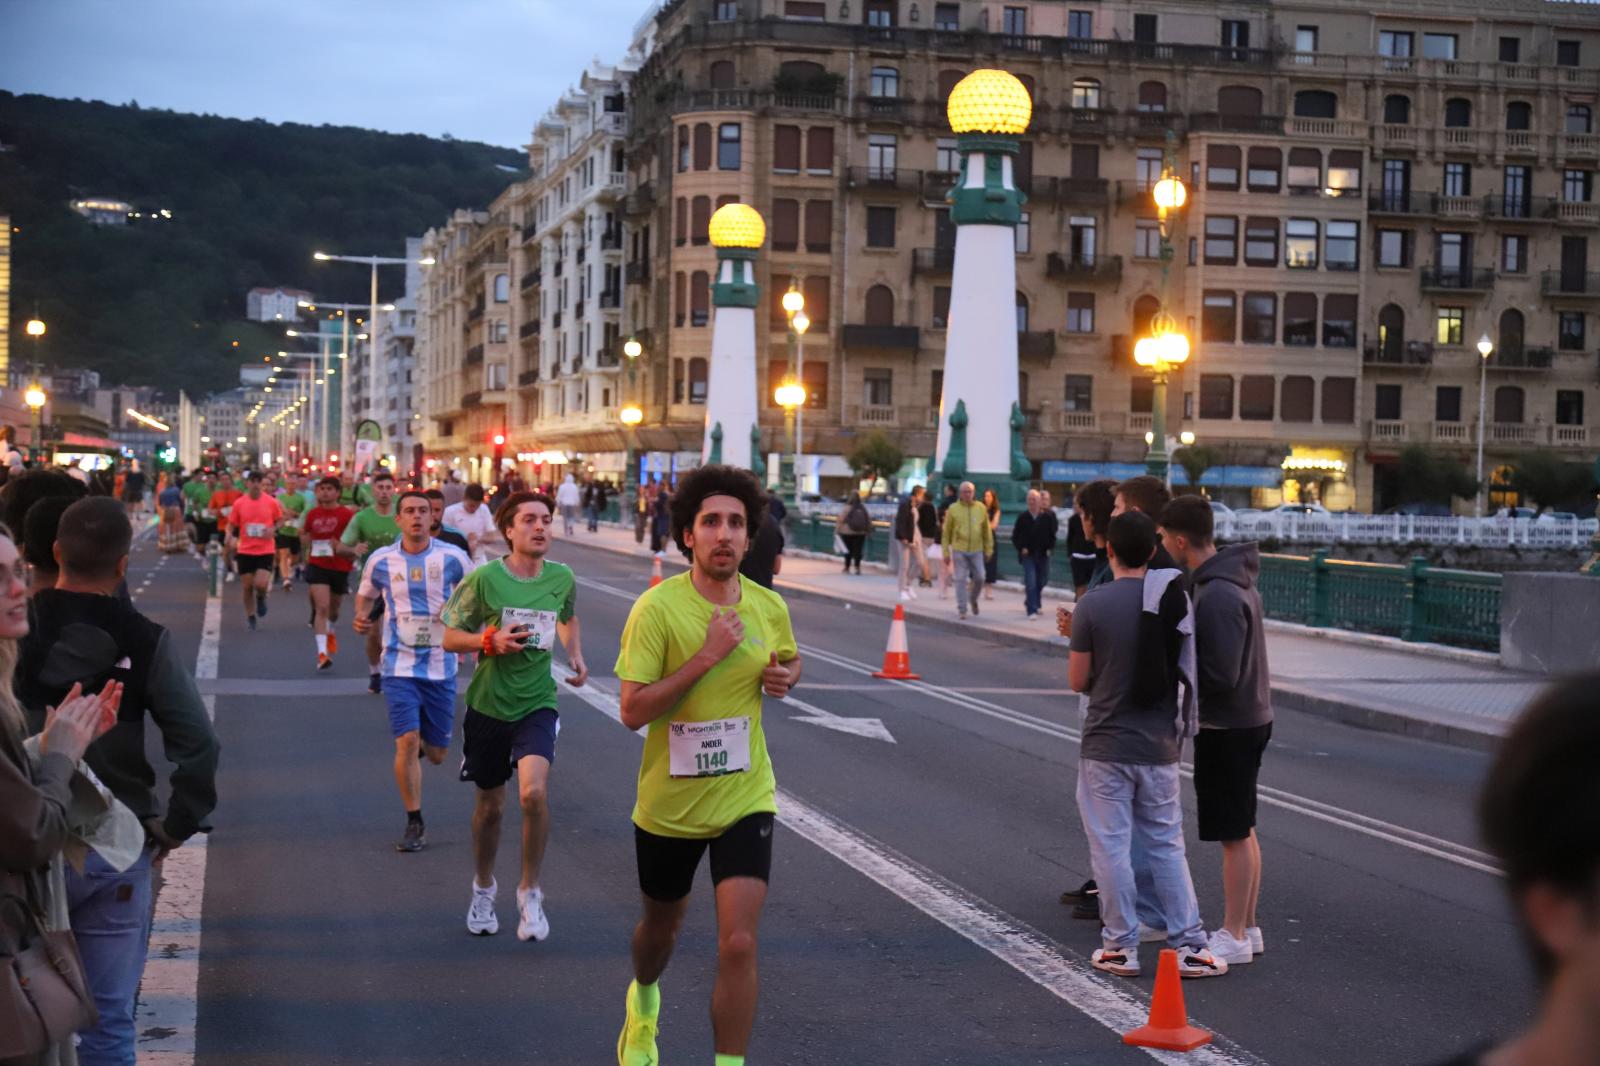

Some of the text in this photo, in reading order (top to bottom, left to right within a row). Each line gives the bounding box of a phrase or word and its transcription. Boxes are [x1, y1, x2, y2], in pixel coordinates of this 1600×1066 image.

[672, 724, 685, 734] 10K
[701, 739, 722, 748] ANDER
[695, 750, 728, 769] 1140
